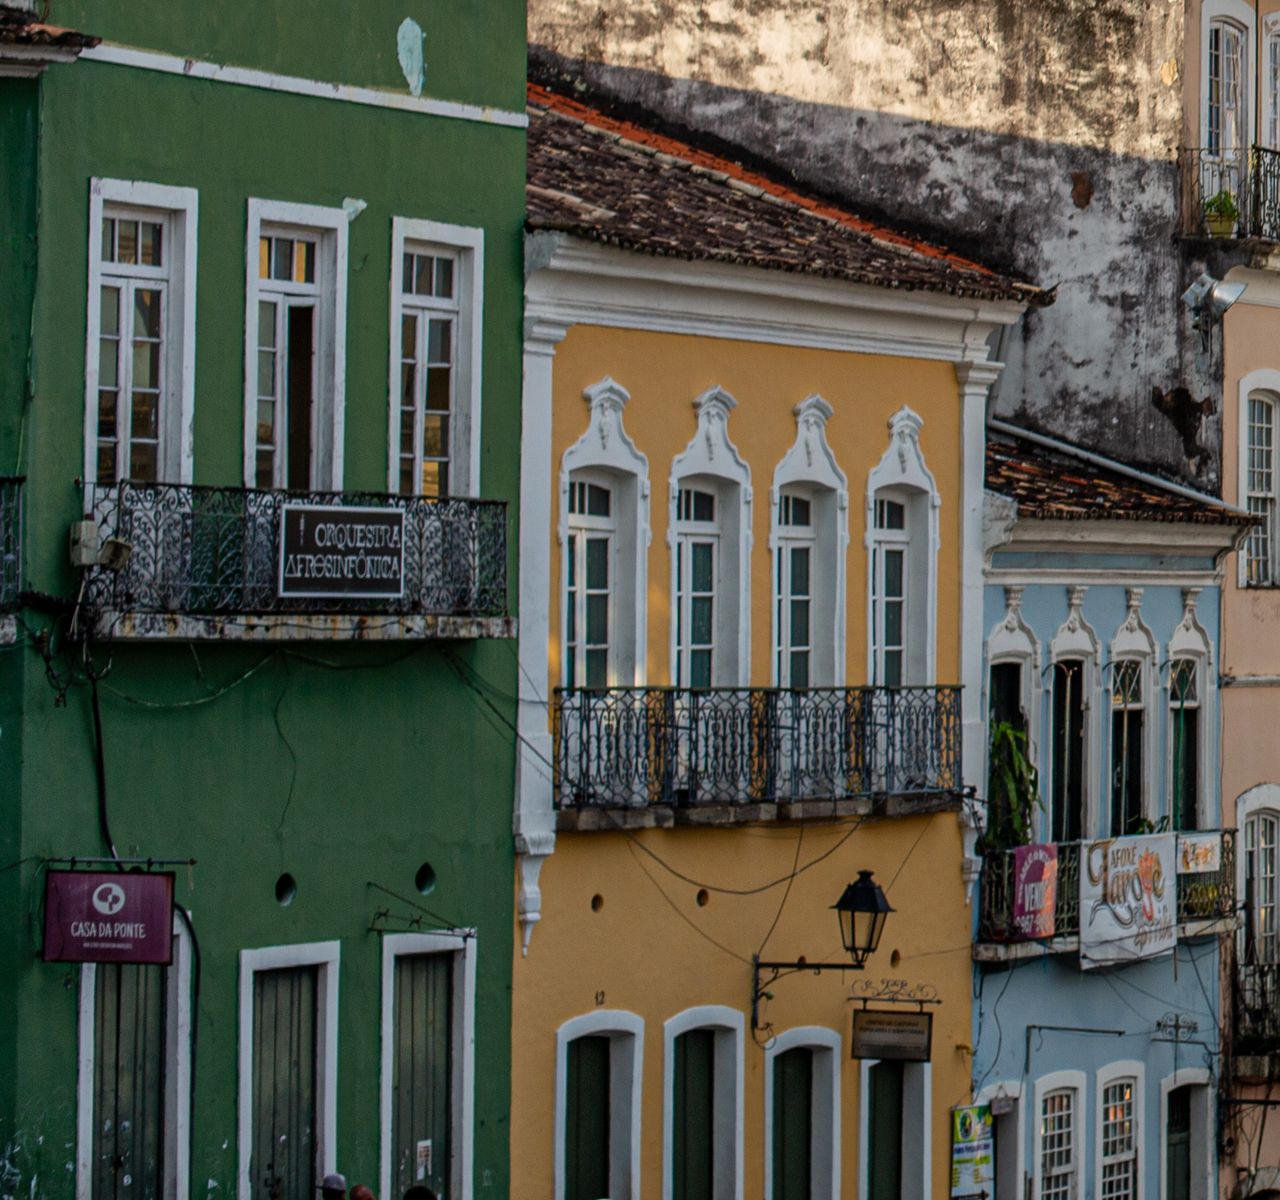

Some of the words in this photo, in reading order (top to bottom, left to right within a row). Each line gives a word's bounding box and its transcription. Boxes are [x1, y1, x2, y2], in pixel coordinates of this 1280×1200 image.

[315, 523, 401, 550] ORQUESTRA
[71, 921, 97, 937] CASA
[99, 922, 113, 937] DA
[114, 923, 146, 938] PONTE
